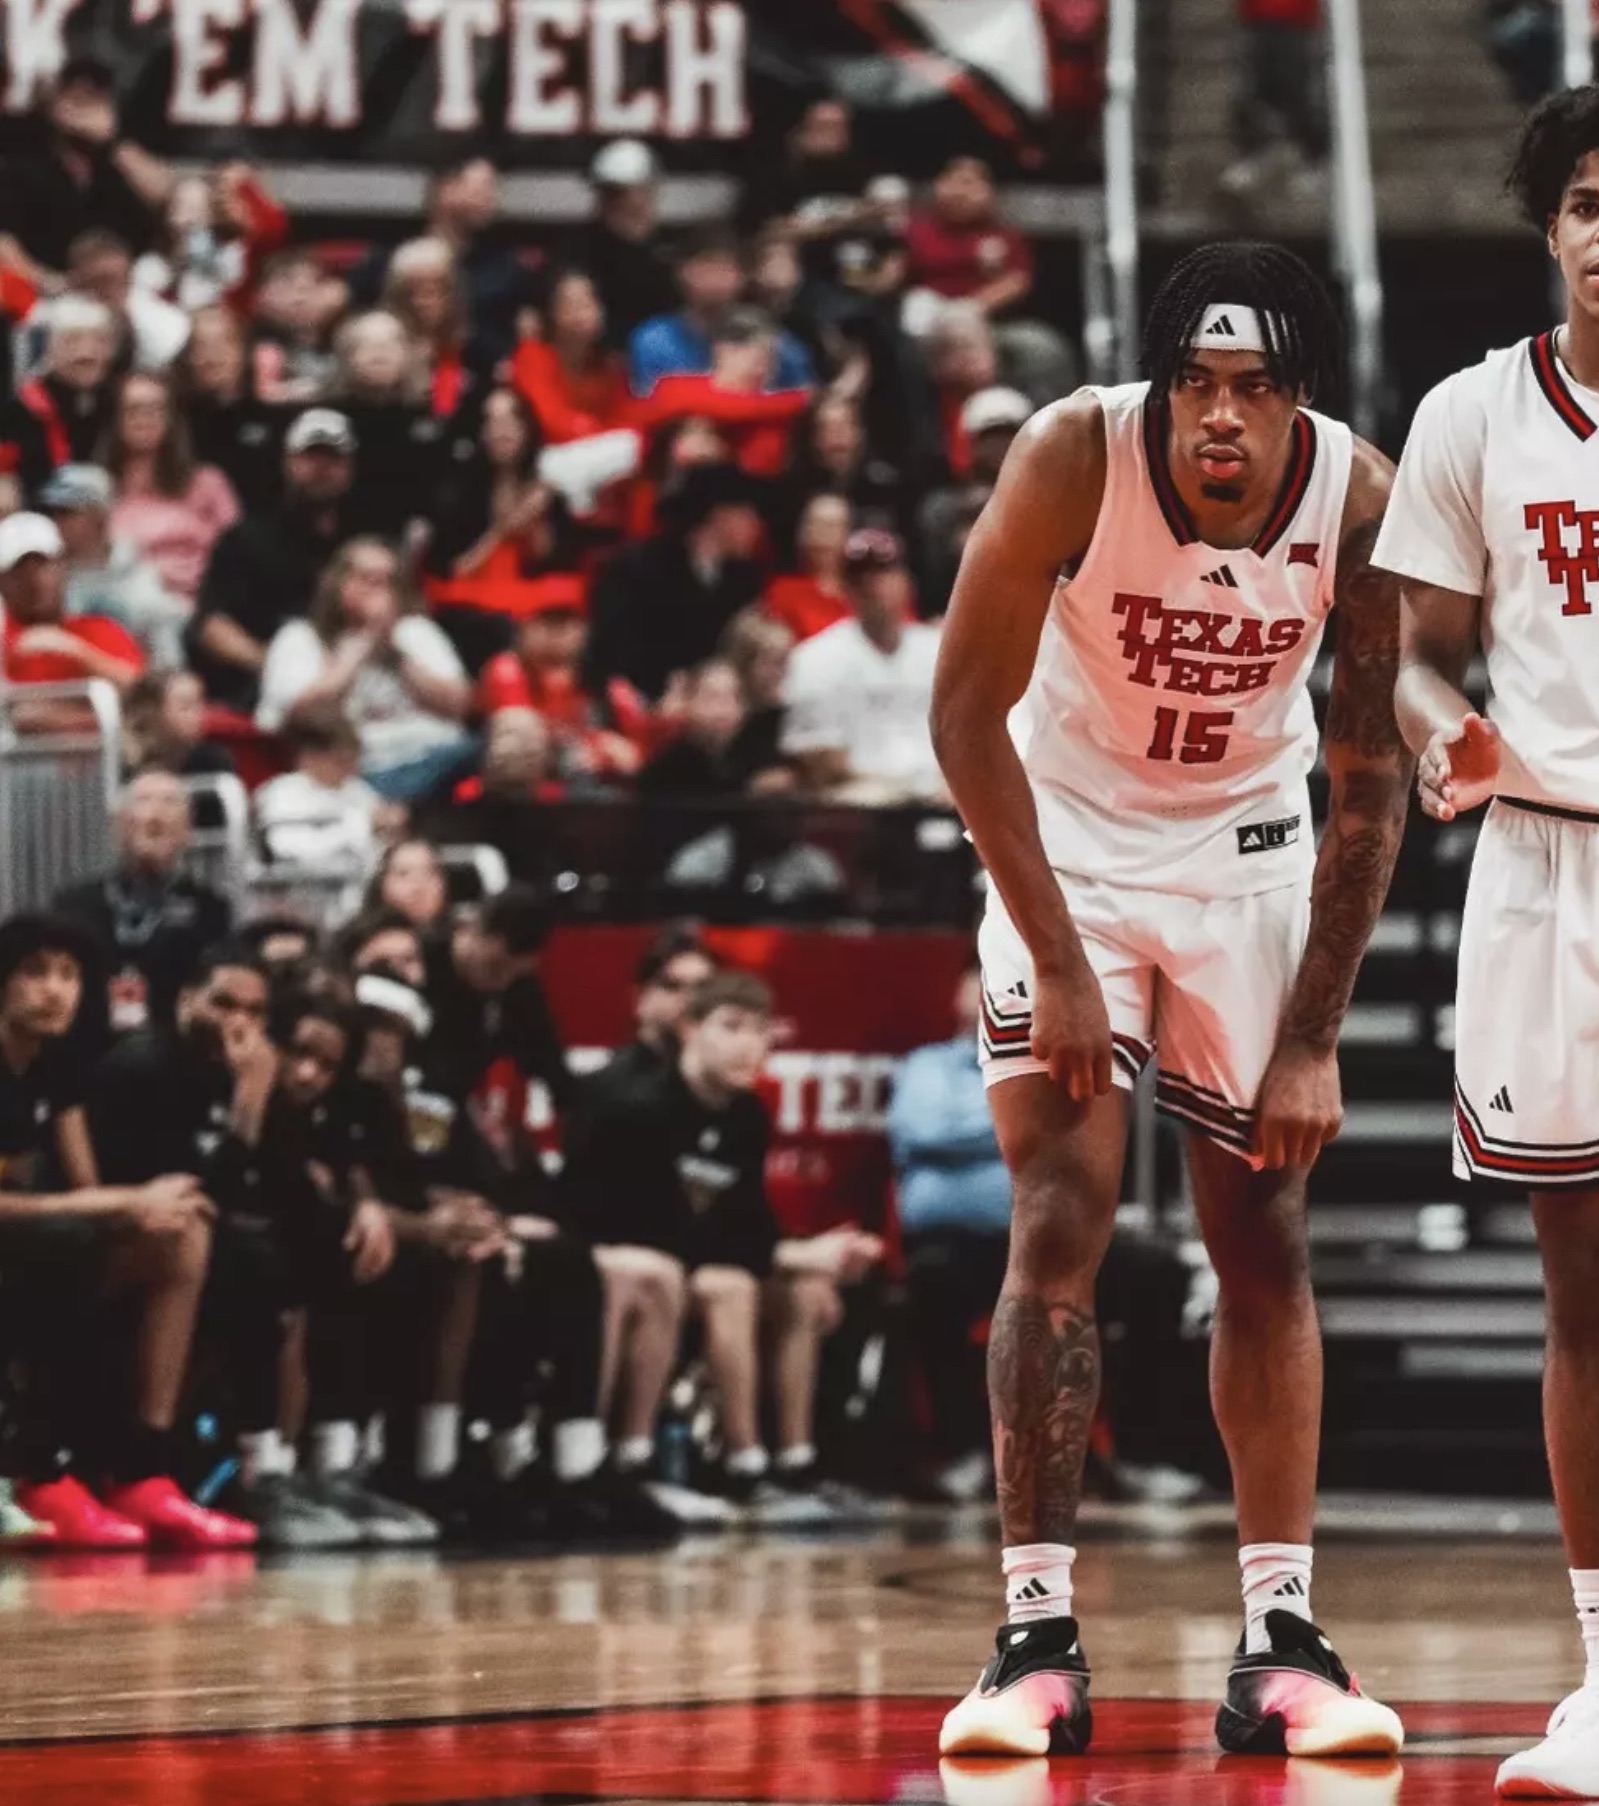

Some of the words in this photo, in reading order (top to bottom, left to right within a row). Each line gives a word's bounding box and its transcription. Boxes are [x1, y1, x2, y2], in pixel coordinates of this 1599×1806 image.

[402, 0, 749, 137] TECH
[1111, 593, 1306, 657] TEXAS
[1122, 641, 1278, 697] TECH
[1146, 705, 1235, 764] 15
